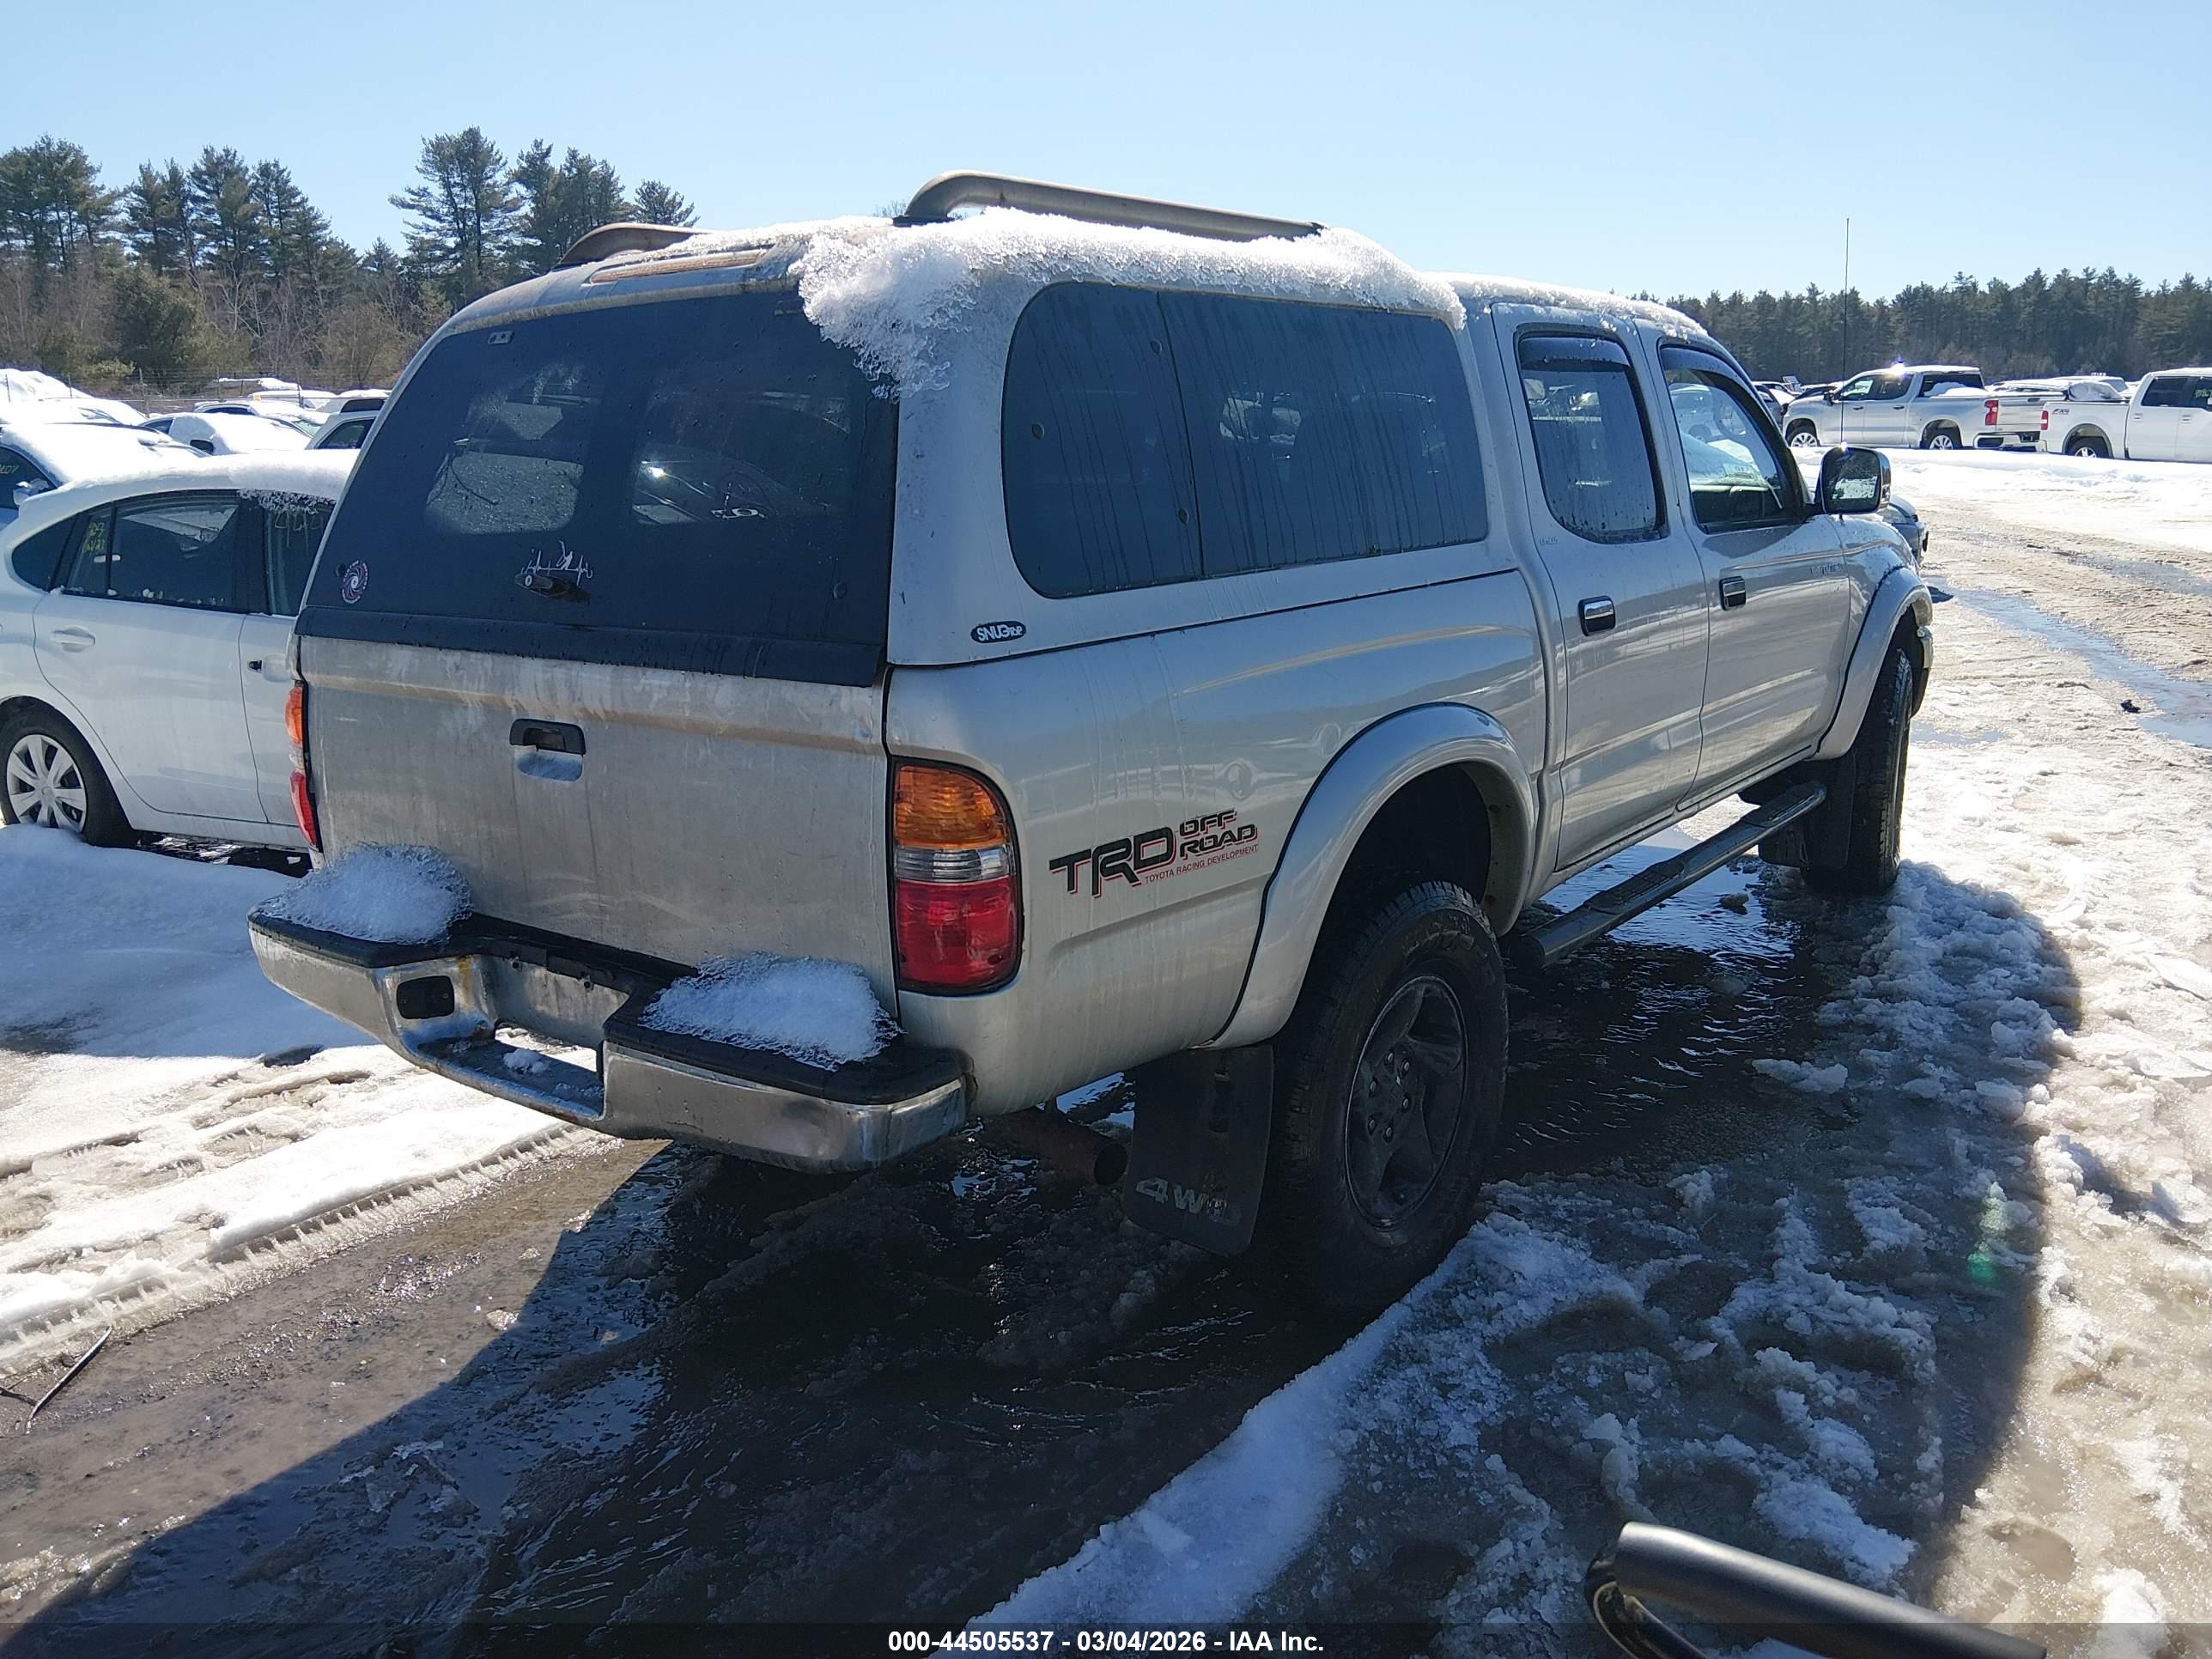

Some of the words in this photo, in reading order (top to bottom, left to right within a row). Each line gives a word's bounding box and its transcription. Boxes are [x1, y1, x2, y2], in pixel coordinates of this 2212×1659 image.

[1179, 808, 1237, 840] OFF
[1179, 823, 1258, 860] ROAD
[1048, 826, 1176, 899] TRD
[1145, 869, 1175, 884] TOYOTA
[1176, 860, 1205, 875] RACING
[1207, 844, 1259, 866] DEVELOPMENT
